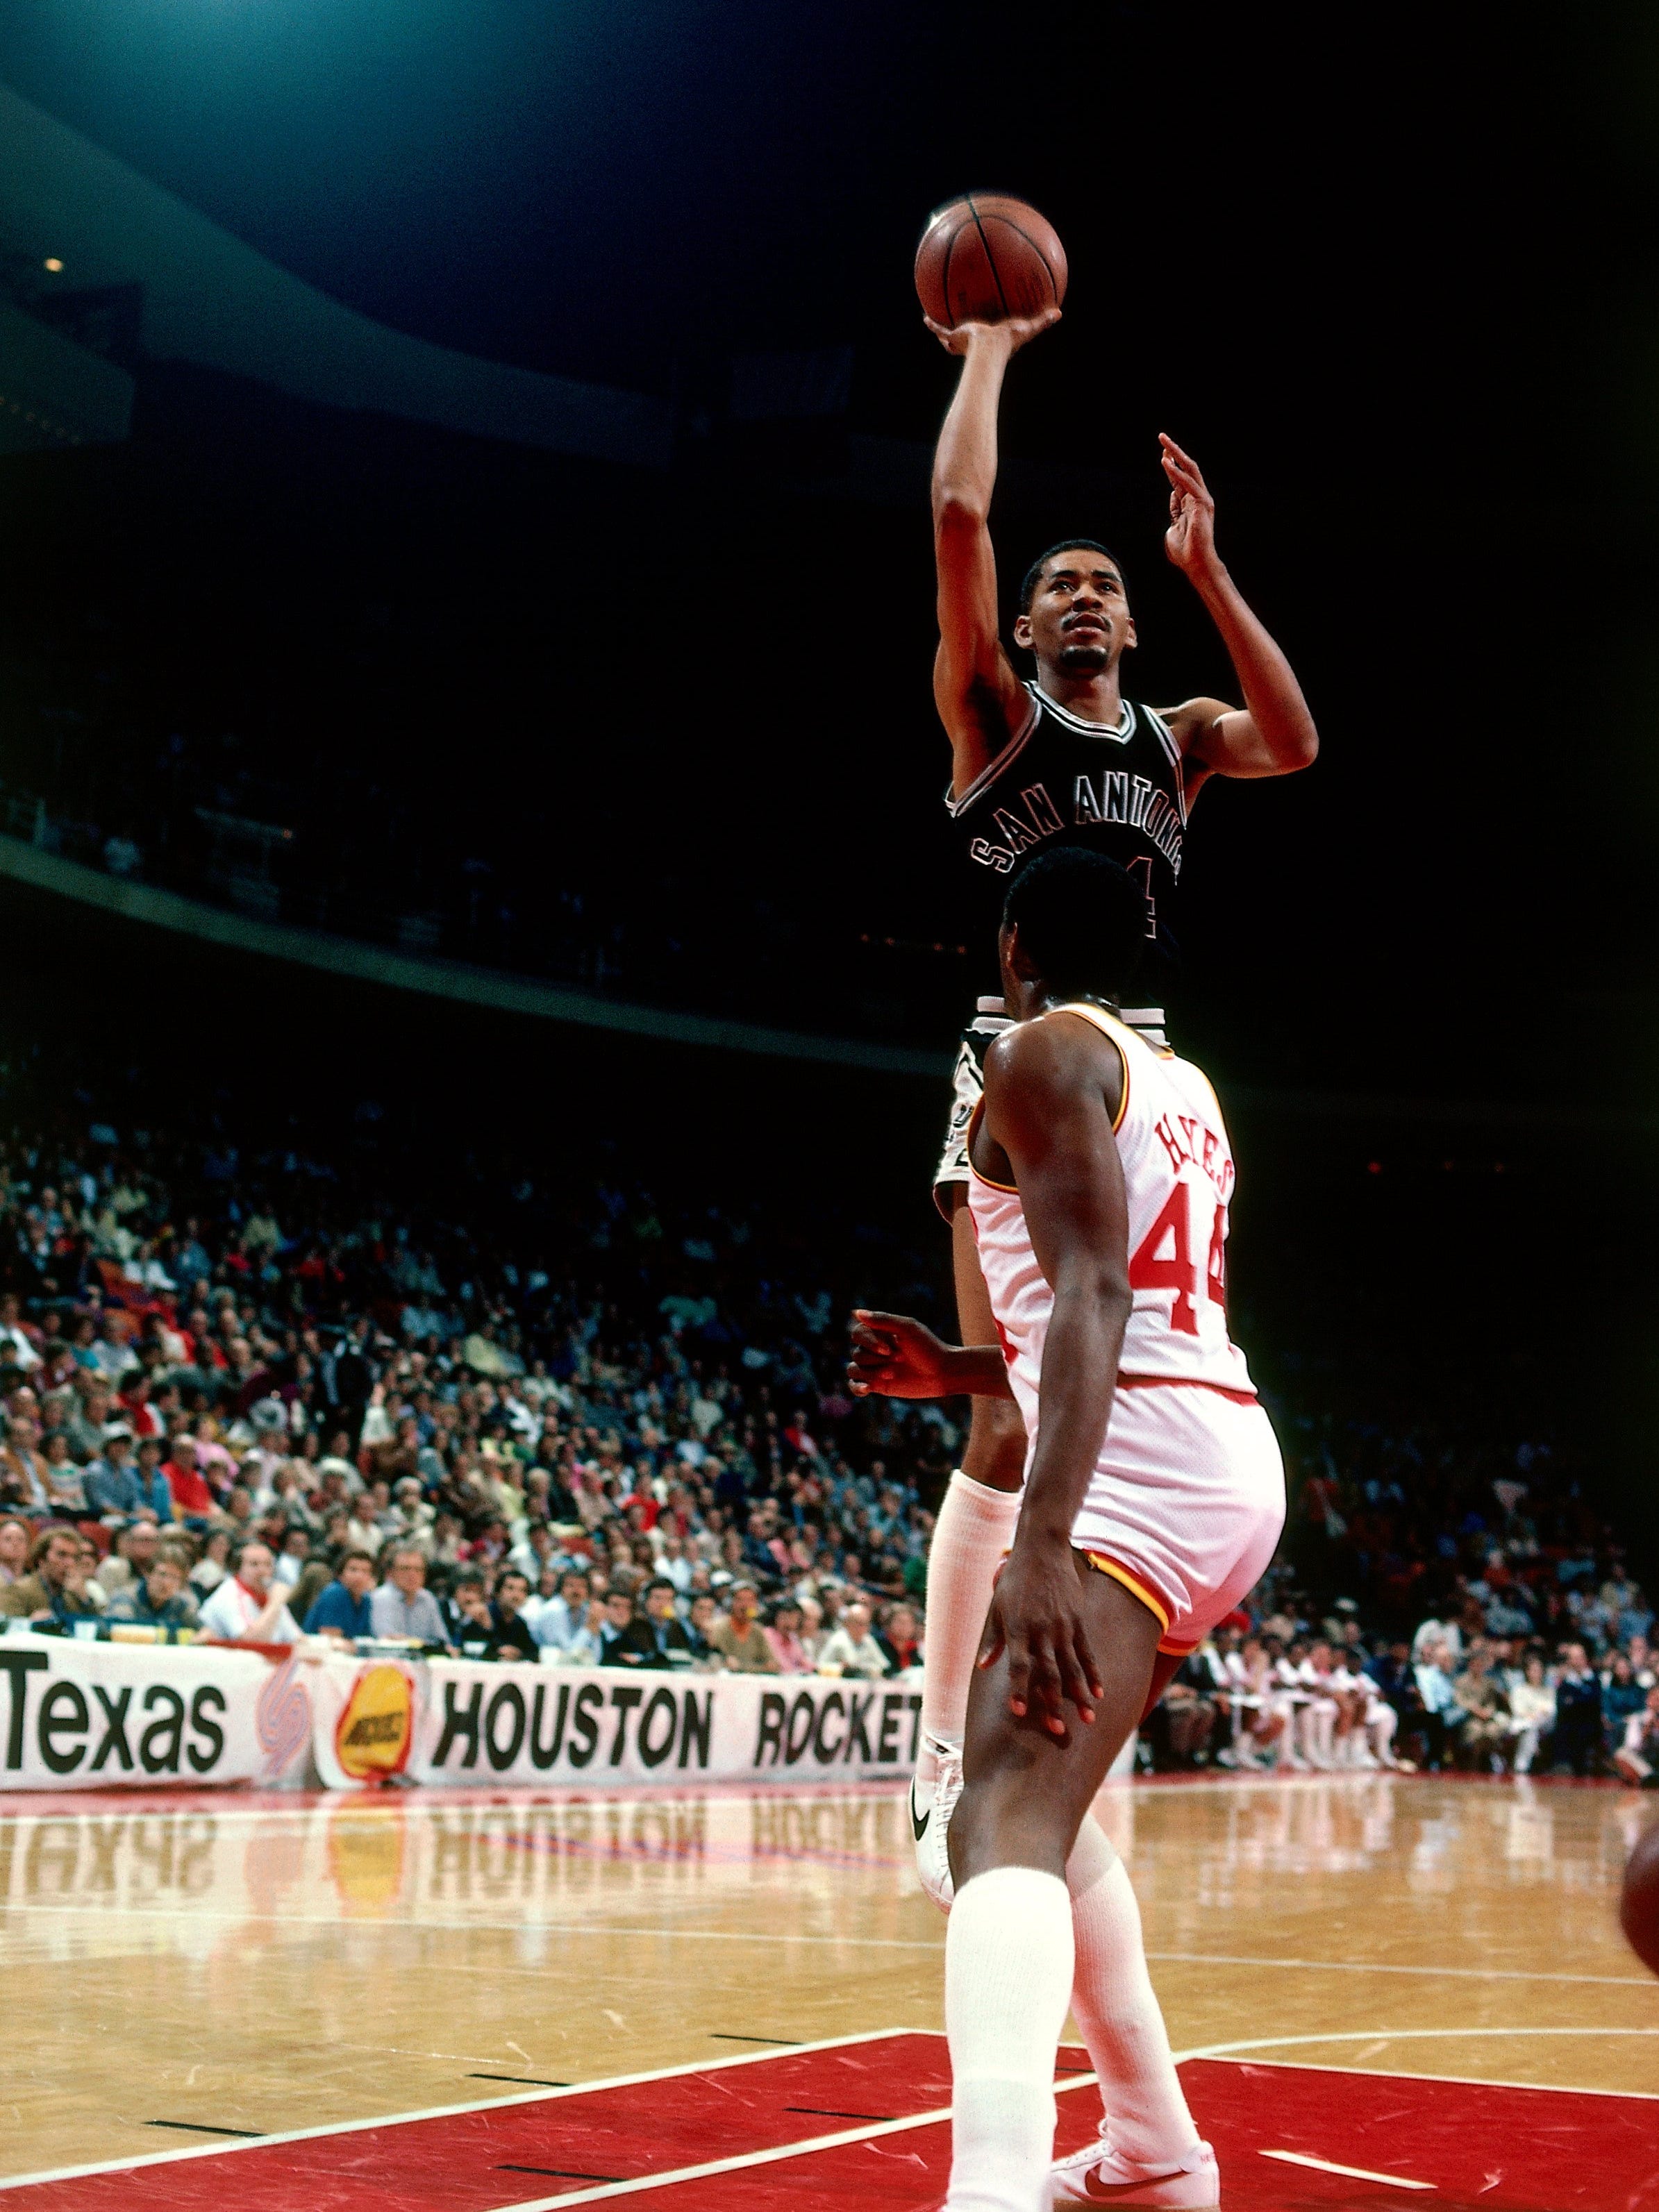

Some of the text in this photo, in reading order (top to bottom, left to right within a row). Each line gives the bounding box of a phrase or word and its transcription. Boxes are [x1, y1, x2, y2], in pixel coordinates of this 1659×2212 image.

[971, 782, 1066, 874] SAN
[0, 1650, 226, 1775] Texas
[431, 1681, 714, 1772] HOUSTON
[753, 1691, 924, 1768] ROCKET
